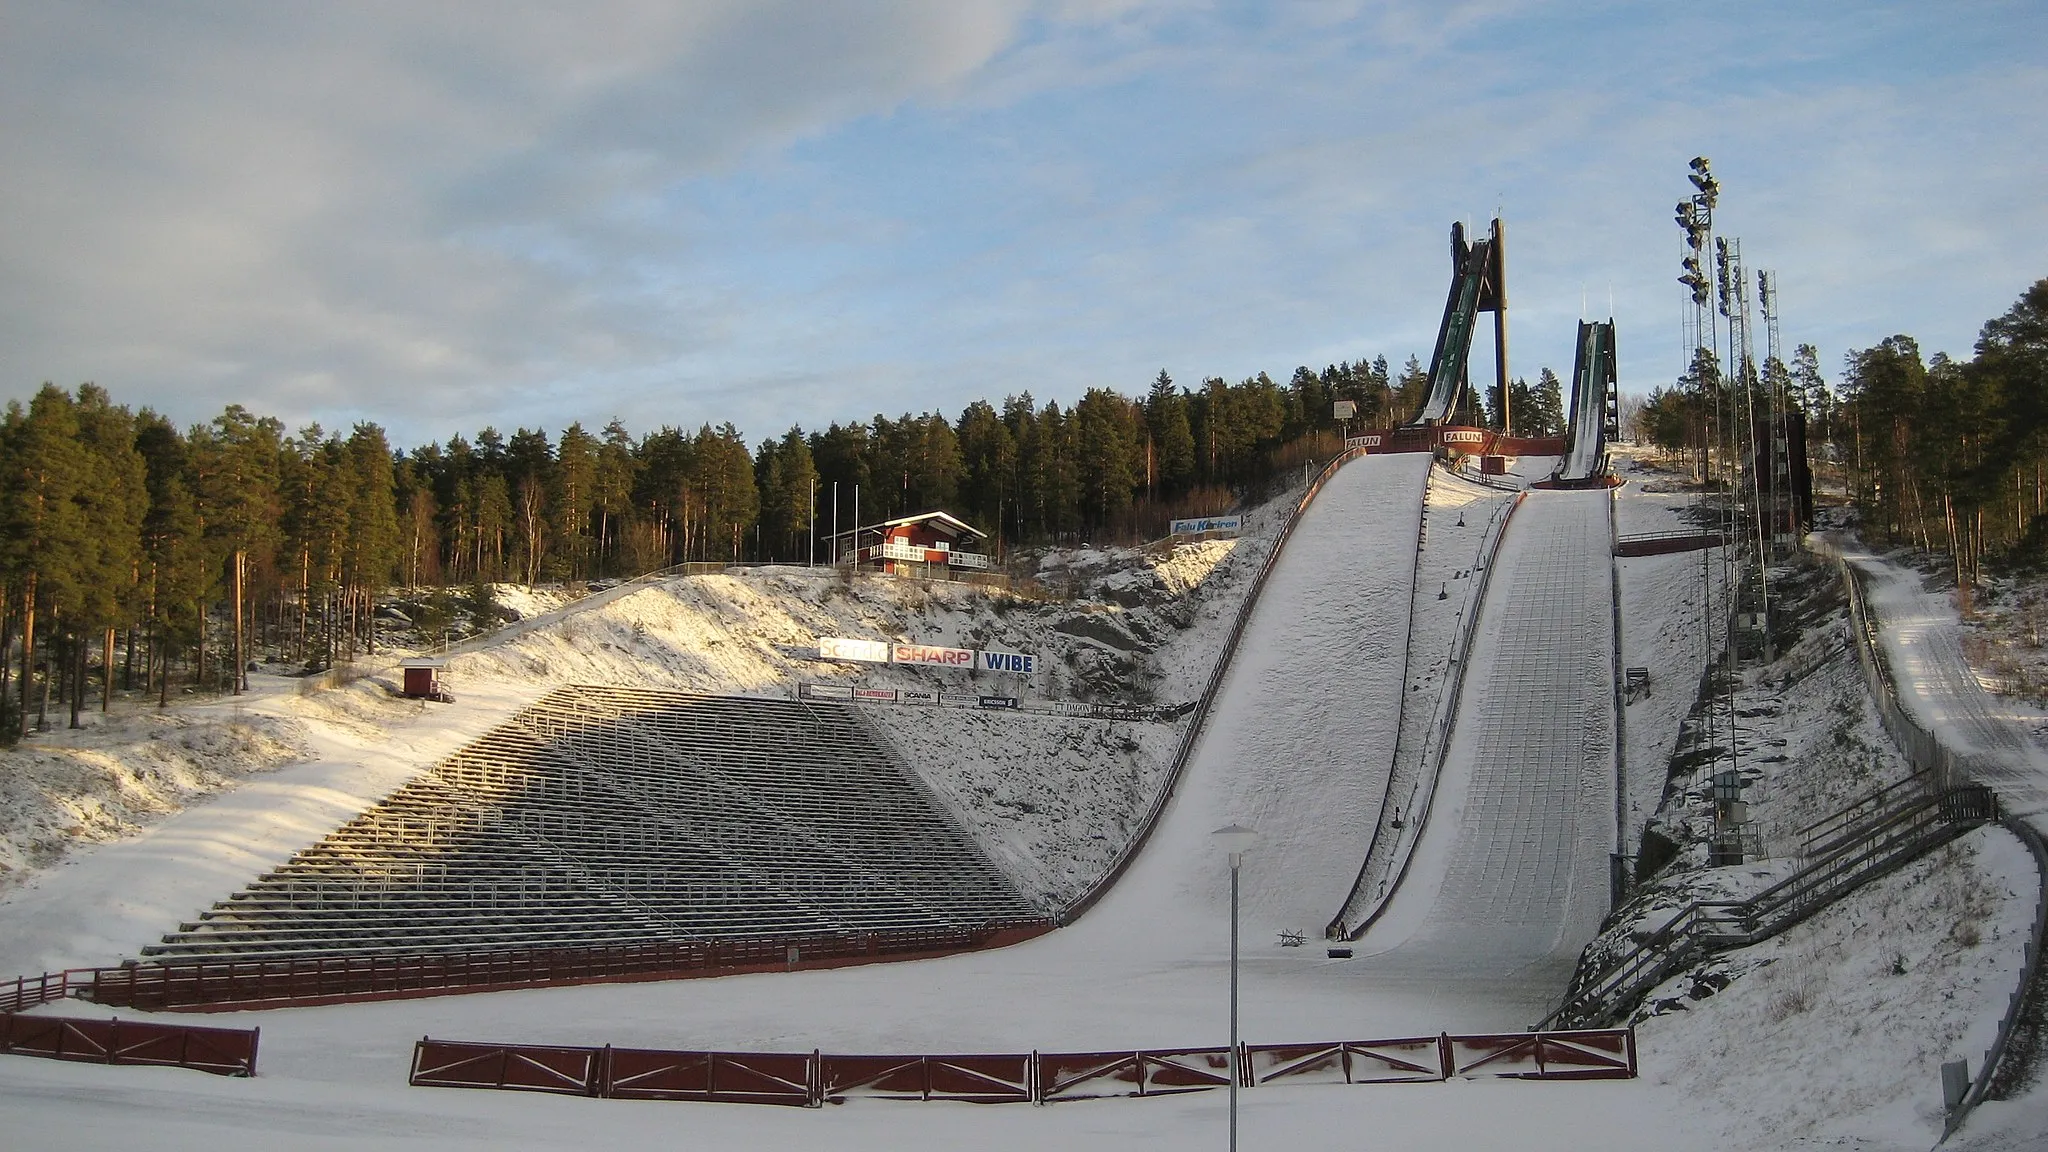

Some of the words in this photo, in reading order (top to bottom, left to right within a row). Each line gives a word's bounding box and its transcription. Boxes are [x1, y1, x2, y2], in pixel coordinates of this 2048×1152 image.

[1346, 436, 1379, 447] FALUN
[1446, 433, 1482, 442] FALUN
[1174, 522, 1196, 533] Falu
[822, 640, 887, 660] Scandic
[896, 645, 971, 665] SHARP
[985, 653, 1033, 672] WIBE
[904, 692, 931, 700] SCANIA
